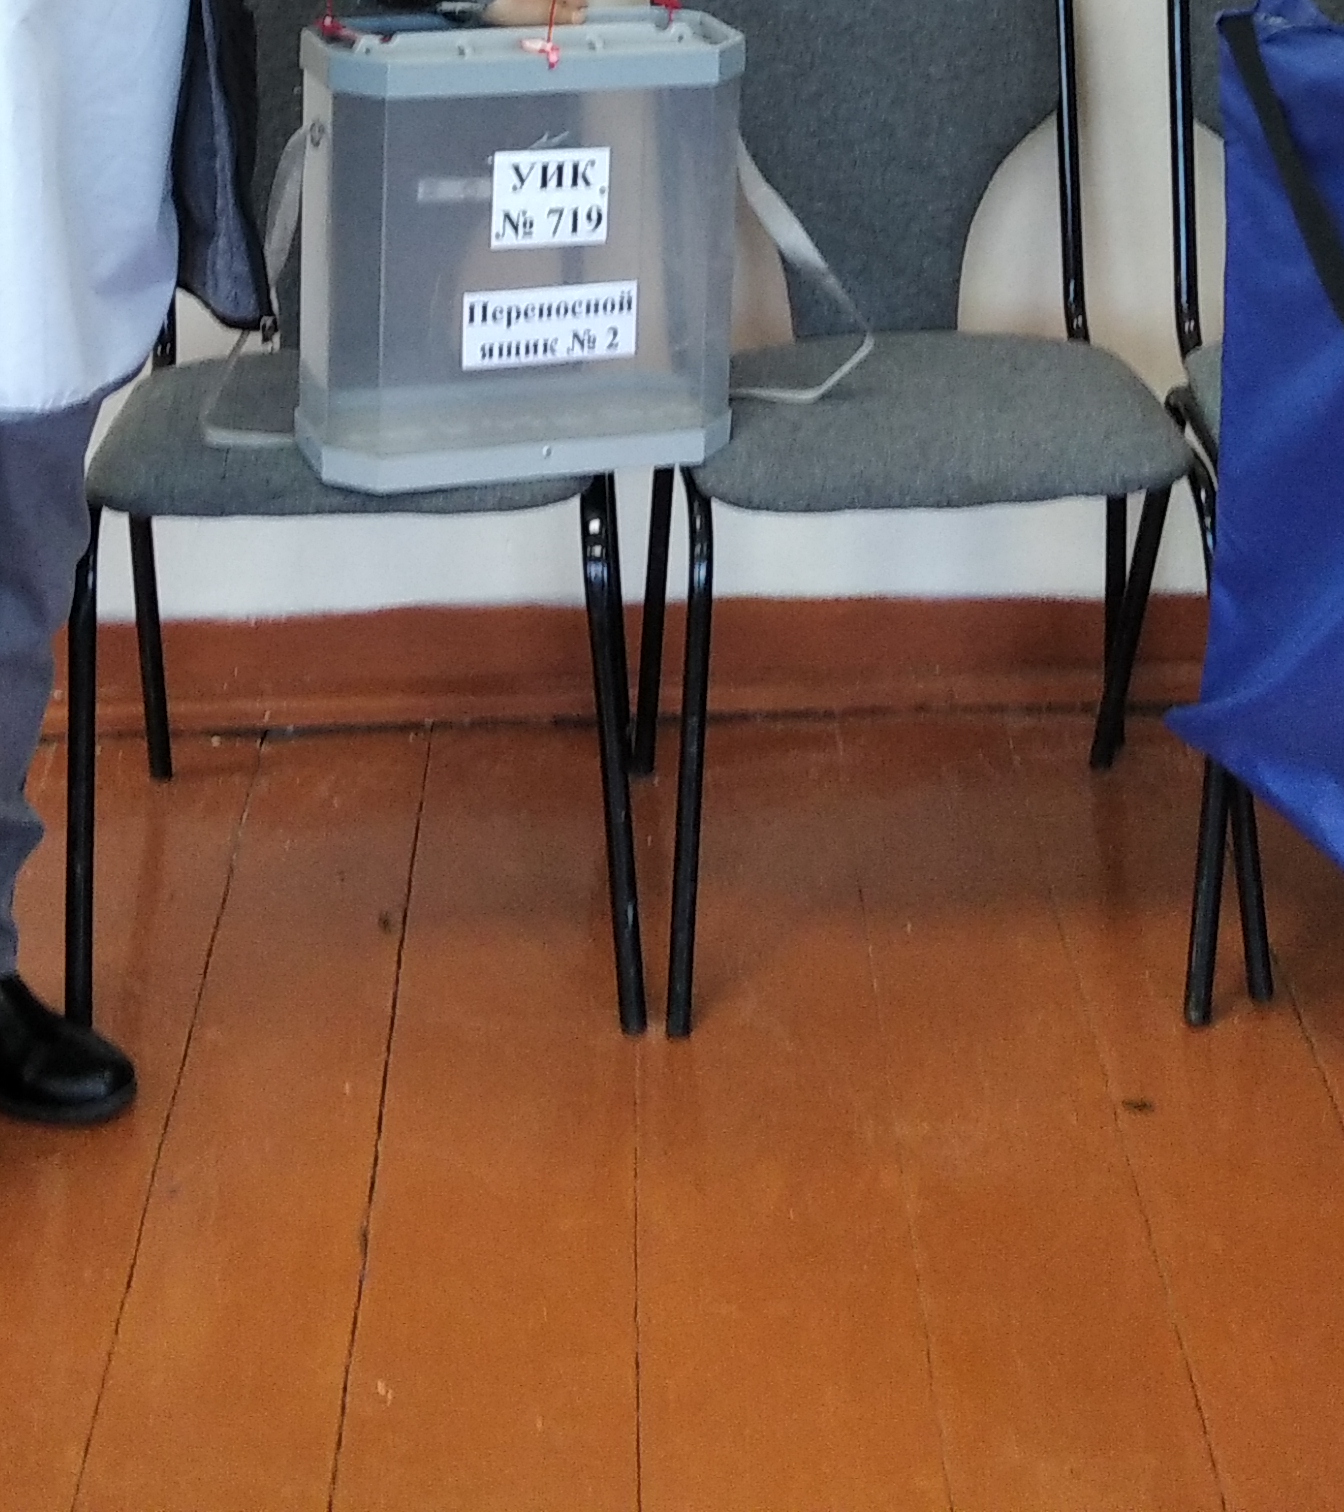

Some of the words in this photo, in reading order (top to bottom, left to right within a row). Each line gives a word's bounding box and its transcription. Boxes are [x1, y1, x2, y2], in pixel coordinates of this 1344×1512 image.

[511, 159, 596, 193] УИК
[495, 209, 534, 241] №
[546, 205, 604, 238] 719
[467, 289, 634, 330] Переносной
[479, 338, 559, 362] ящик
[566, 328, 597, 355] №
[606, 326, 621, 350] 2
